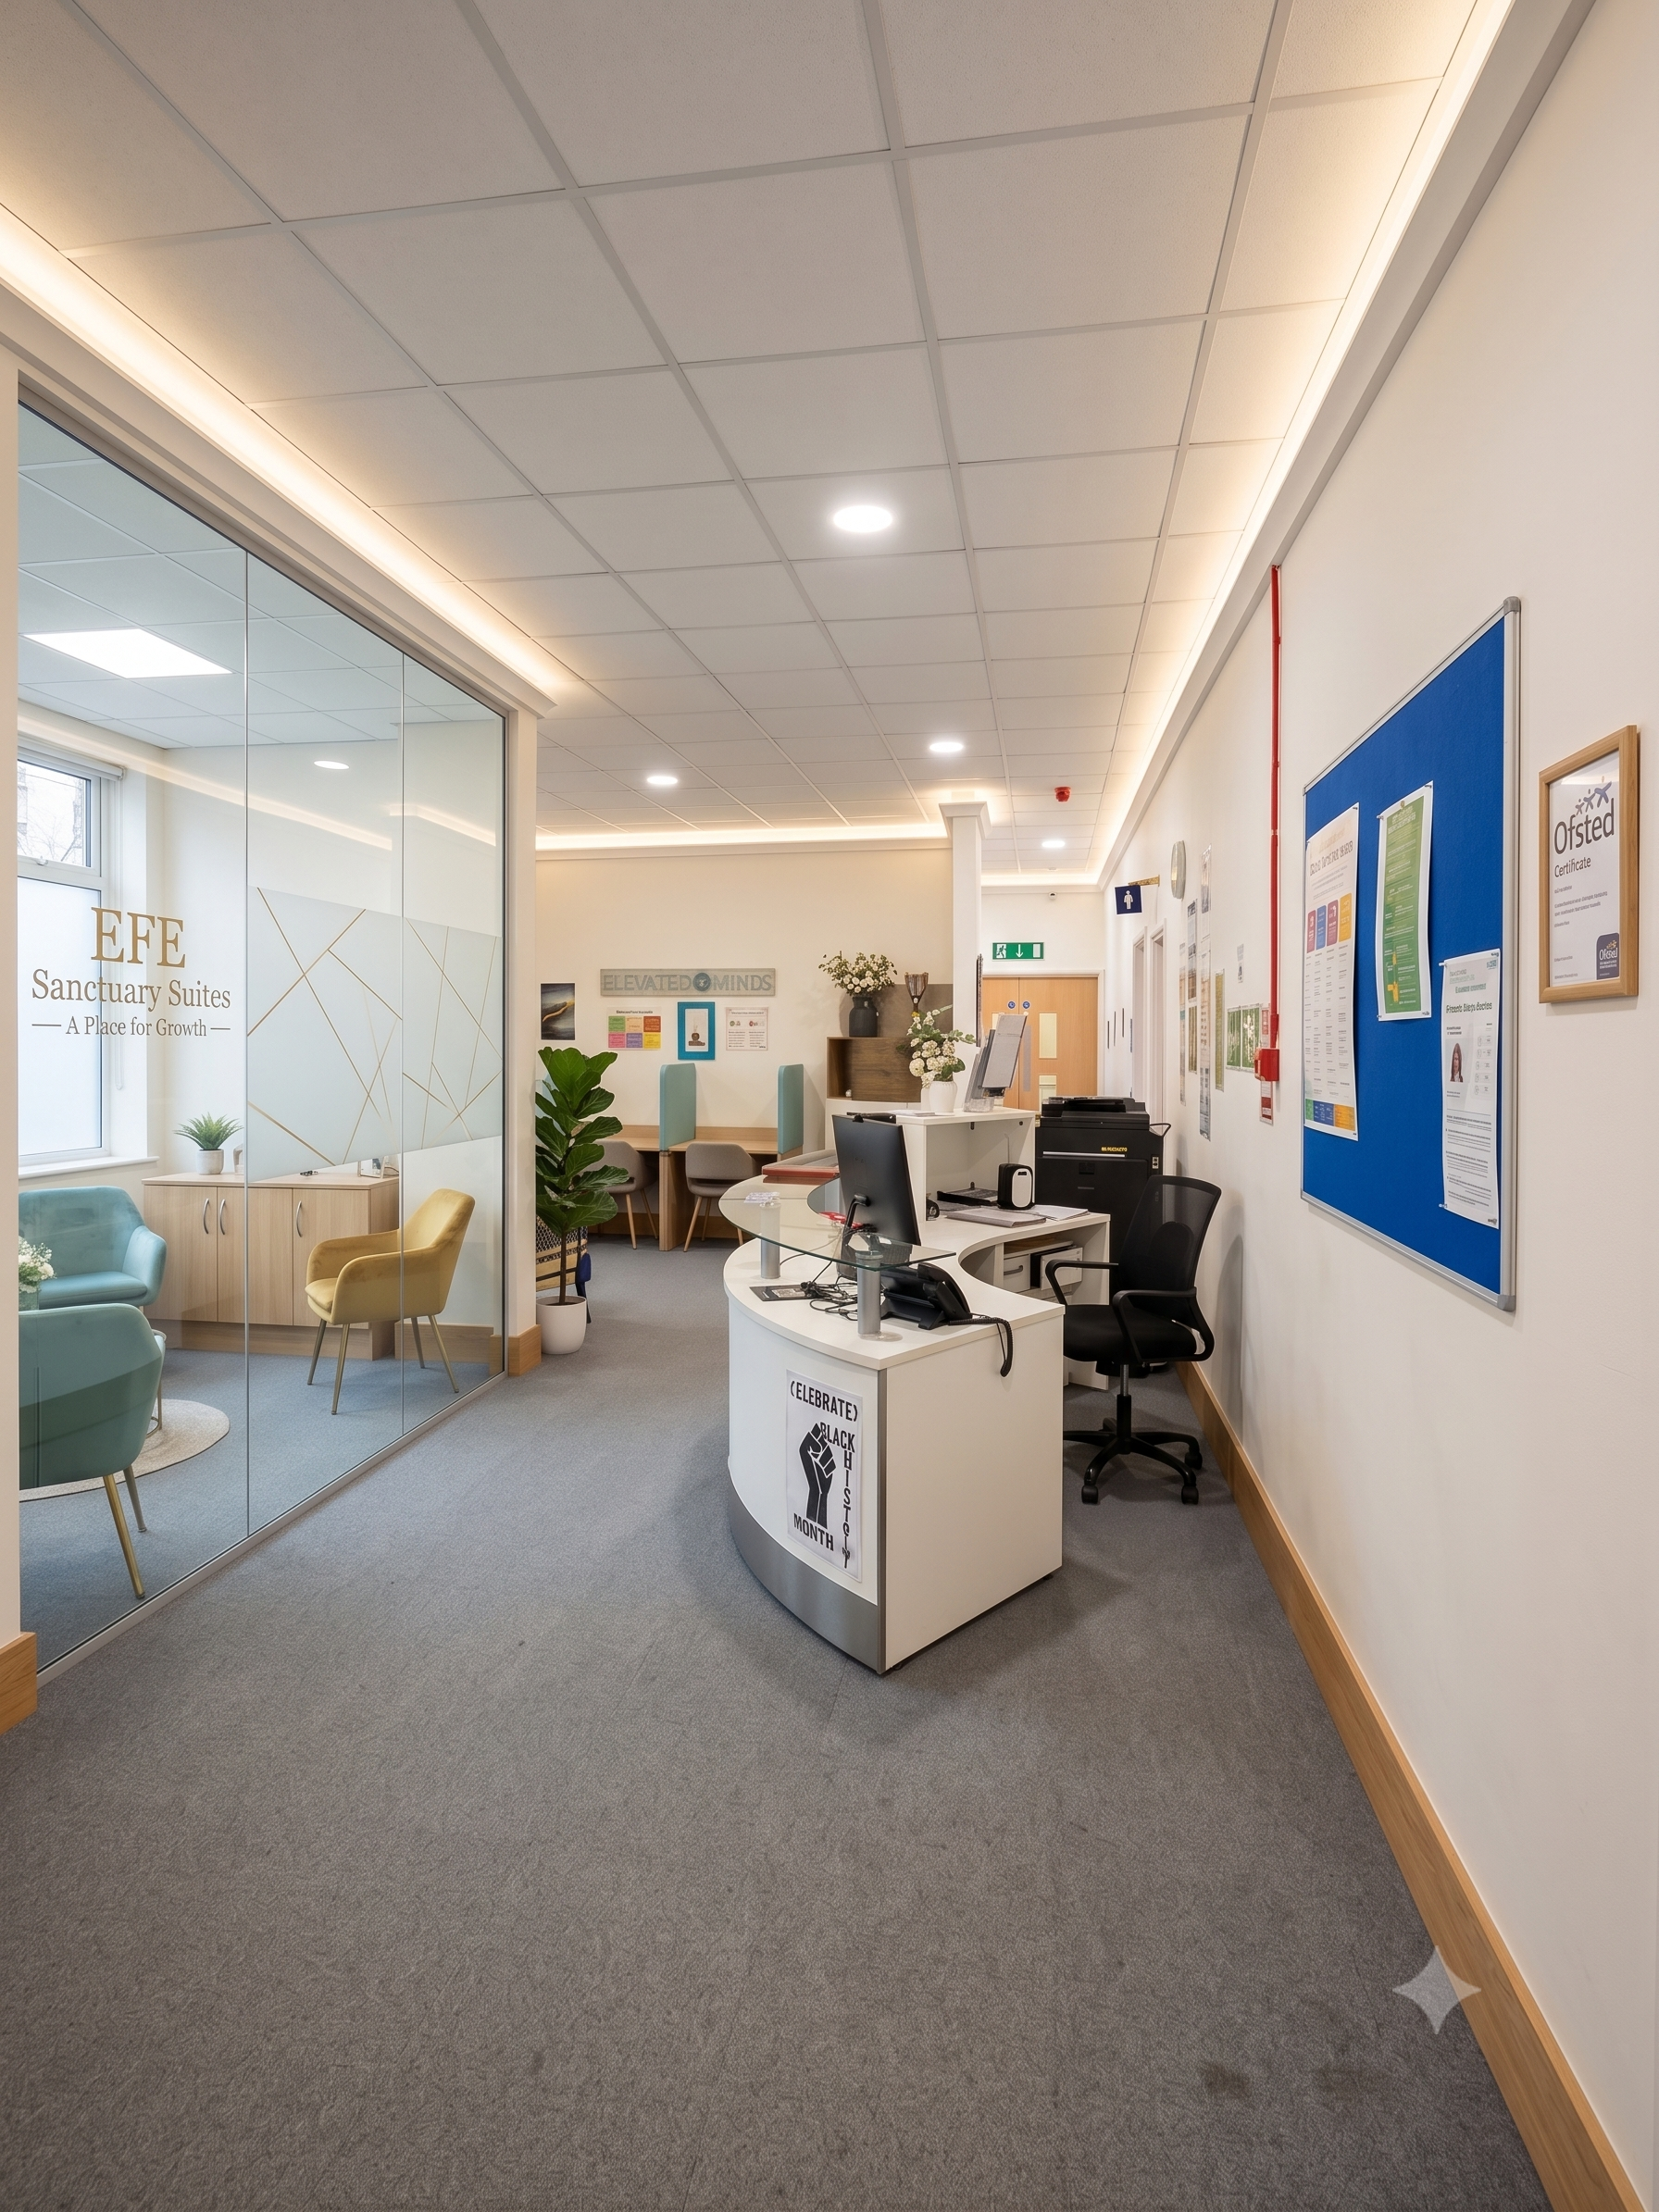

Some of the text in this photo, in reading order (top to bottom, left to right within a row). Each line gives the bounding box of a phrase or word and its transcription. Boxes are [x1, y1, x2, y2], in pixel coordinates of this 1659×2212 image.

[1554, 798, 1615, 854] Ofsted
[1554, 857, 1591, 877] Certificate
[91, 907, 186, 968] EFE
[32, 969, 231, 1012] Sanctuary Suites
[603, 975, 773, 991] ELEVATED MINDS
[66, 1015, 206, 1037] A Place for Growth
[820, 1422, 855, 1453] BLACK
[793, 1512, 834, 1552] MONTH
